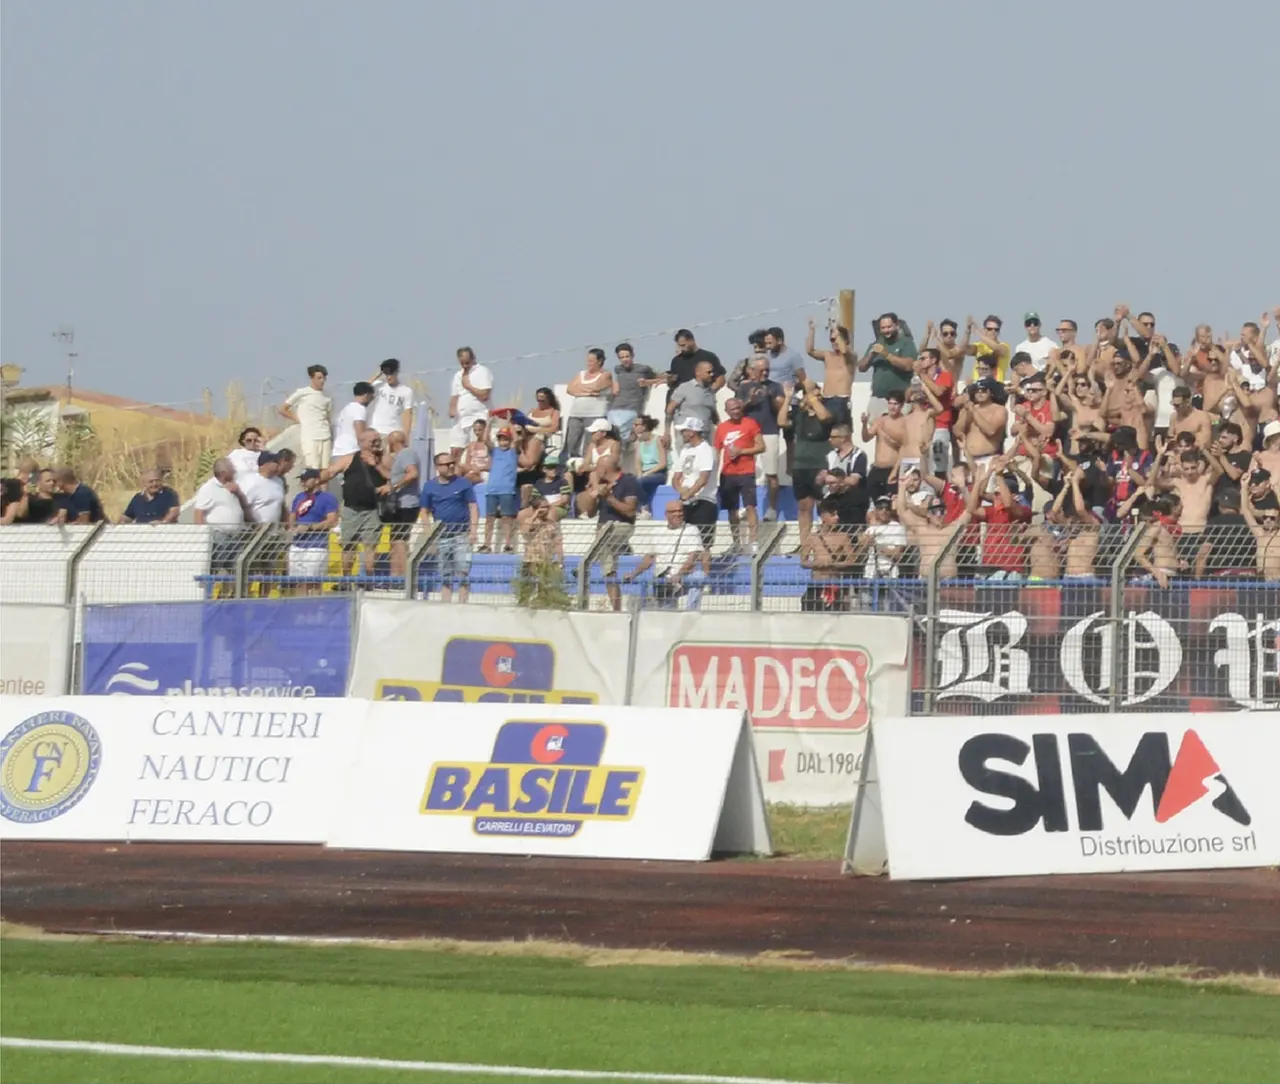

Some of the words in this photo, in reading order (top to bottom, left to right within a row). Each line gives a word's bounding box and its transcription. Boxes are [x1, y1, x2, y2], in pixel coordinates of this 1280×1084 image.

[678, 655, 861, 720] MADEO
[152, 710, 322, 739] CANTIERI
[138, 754, 292, 783] NAUTICI
[797, 752, 825, 774] DAL
[425, 767, 640, 815] BASILE
[957, 728, 1252, 836] SIMA
[127, 799, 273, 826] FERACO
[477, 821, 524, 833] CARRELLI
[524, 822, 575, 834] ELEVATORI
[1080, 834, 1224, 857] Distribuzione
[1232, 832, 1257, 852] srl
